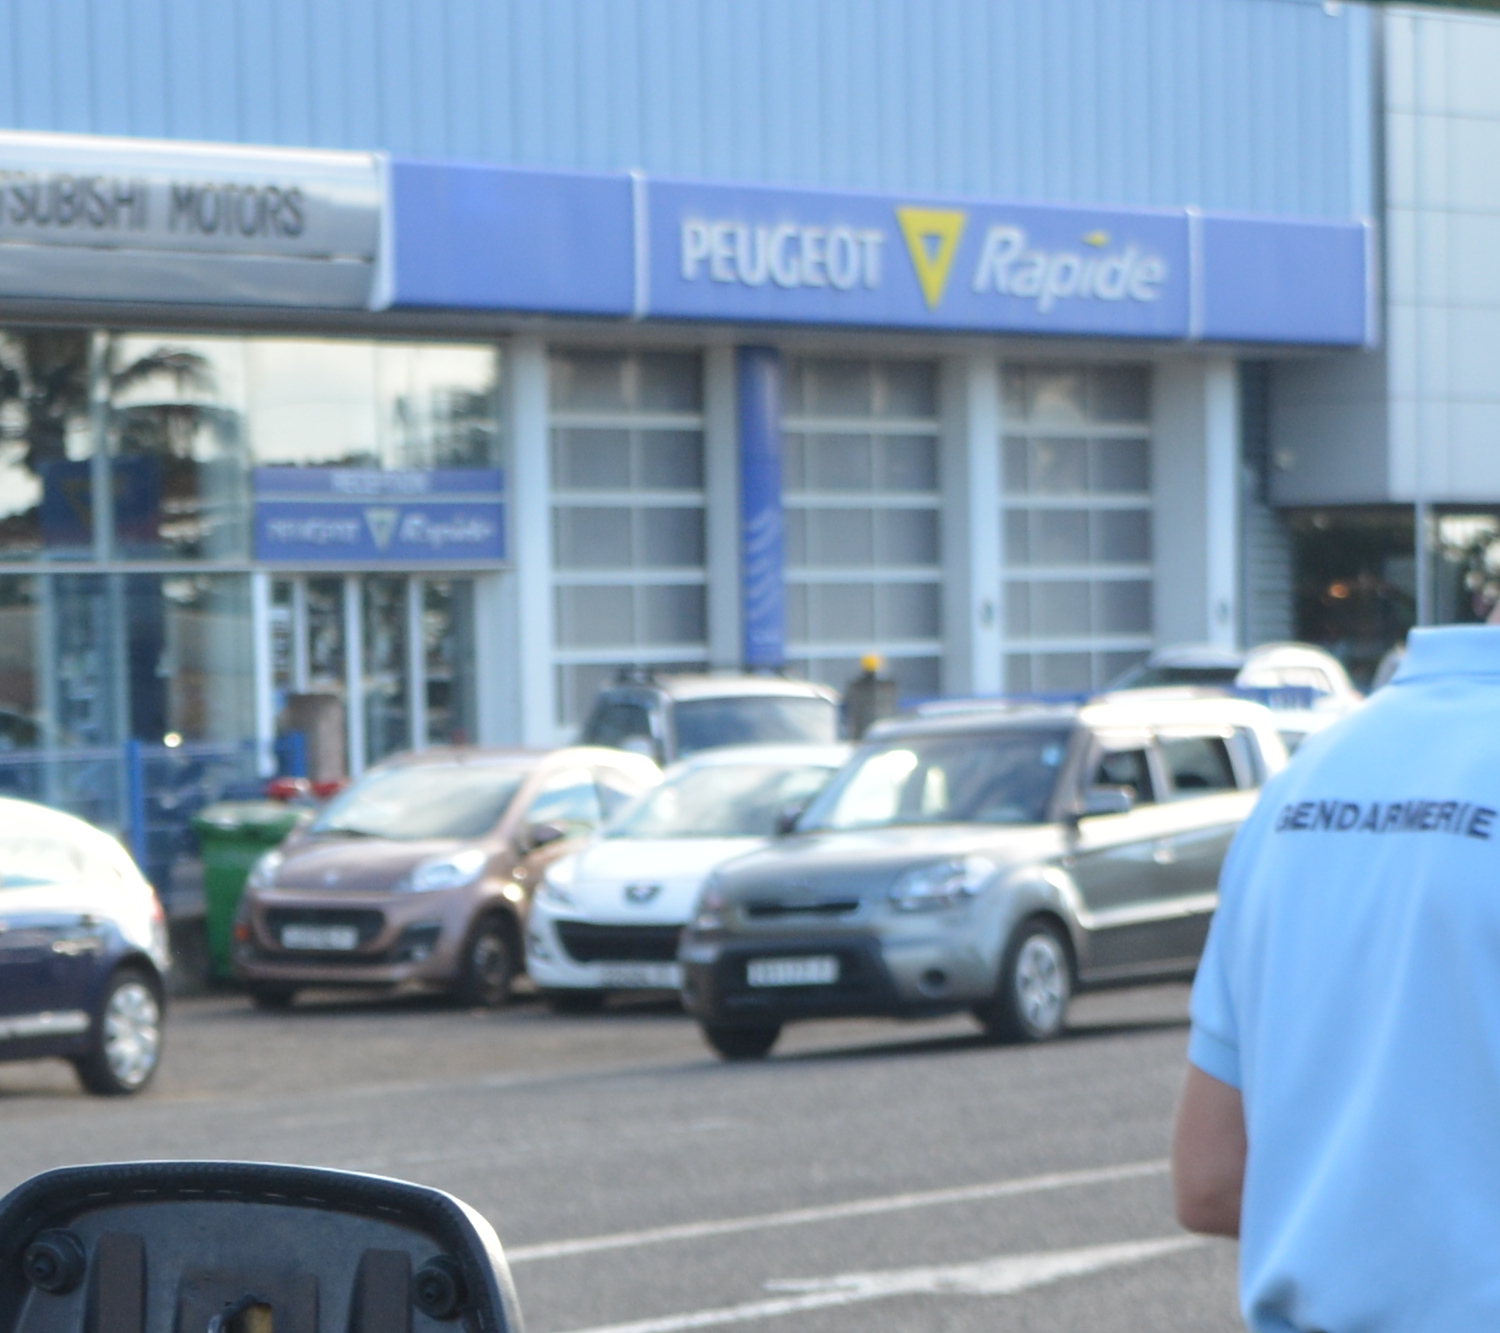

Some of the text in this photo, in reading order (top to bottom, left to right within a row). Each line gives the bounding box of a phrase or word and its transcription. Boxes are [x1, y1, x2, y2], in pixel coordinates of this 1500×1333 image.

[168, 180, 305, 238] MOTORS
[678, 218, 1167, 314] PEUGEOT Rapide
[1275, 799, 1498, 840] GENDARMERIE
